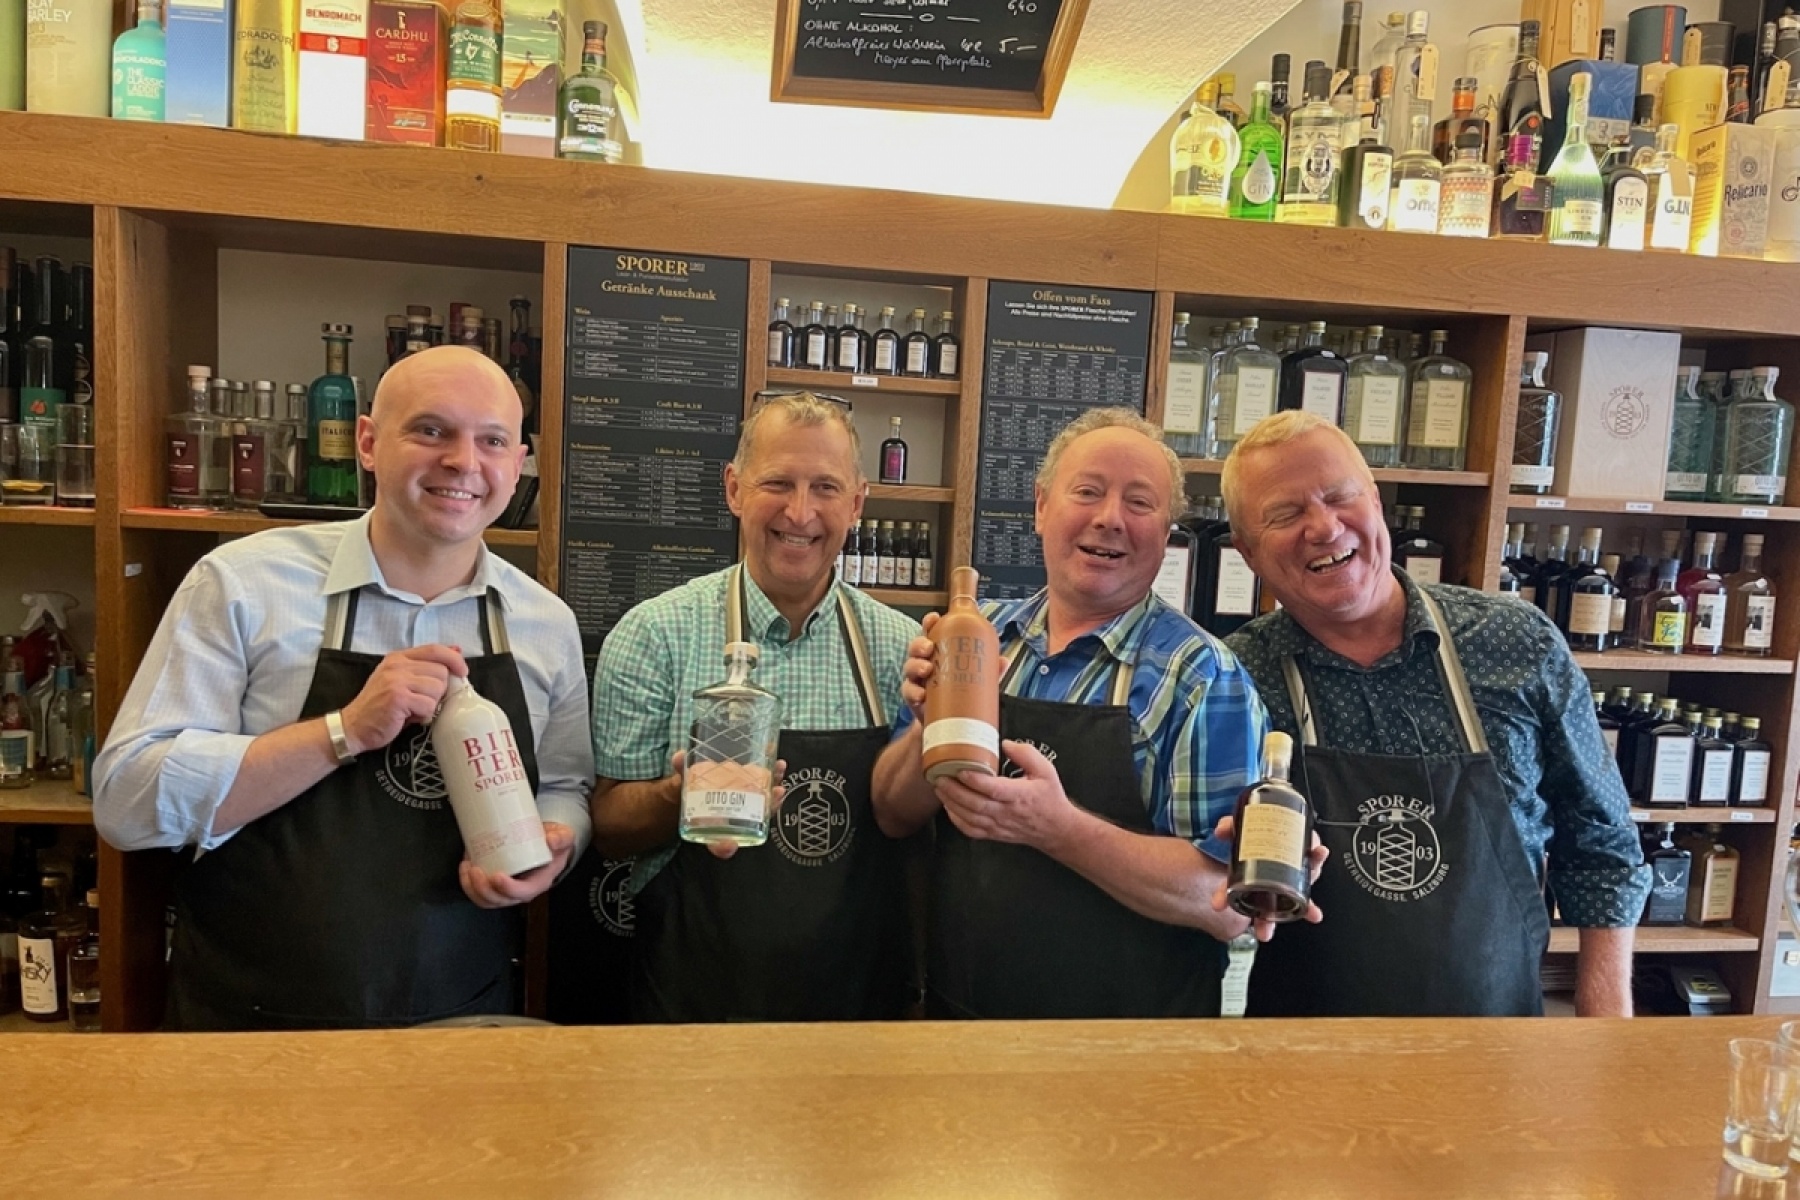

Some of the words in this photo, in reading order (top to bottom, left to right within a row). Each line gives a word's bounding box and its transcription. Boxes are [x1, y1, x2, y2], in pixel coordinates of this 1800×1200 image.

[306, 8, 362, 23] BENROMACH
[804, 20, 841, 31] OHNE
[375, 28, 430, 43] CARDHU
[326, 36, 339, 52] 15
[396, 53, 407, 63] 15
[1617, 196, 1643, 208] STIN
[1724, 183, 1768, 207] Relicario
[617, 255, 689, 276] SPORER
[601, 280, 654, 296] Getränke
[657, 285, 717, 301] Ausschank
[1032, 290, 1063, 302] Offen
[1065, 296, 1087, 304] vom
[1090, 294, 1111, 306] Fass
[463, 729, 512, 759] BIT
[393, 752, 411, 768] 19
[468, 750, 522, 778] TER
[781, 767, 847, 790] SPORER
[705, 791, 727, 805] OTTO
[729, 792, 746, 807] GIN
[1357, 794, 1435, 820] SPORER
[784, 813, 799, 827] 19
[1360, 841, 1377, 856] 19
[1415, 845, 1434, 861] 03
